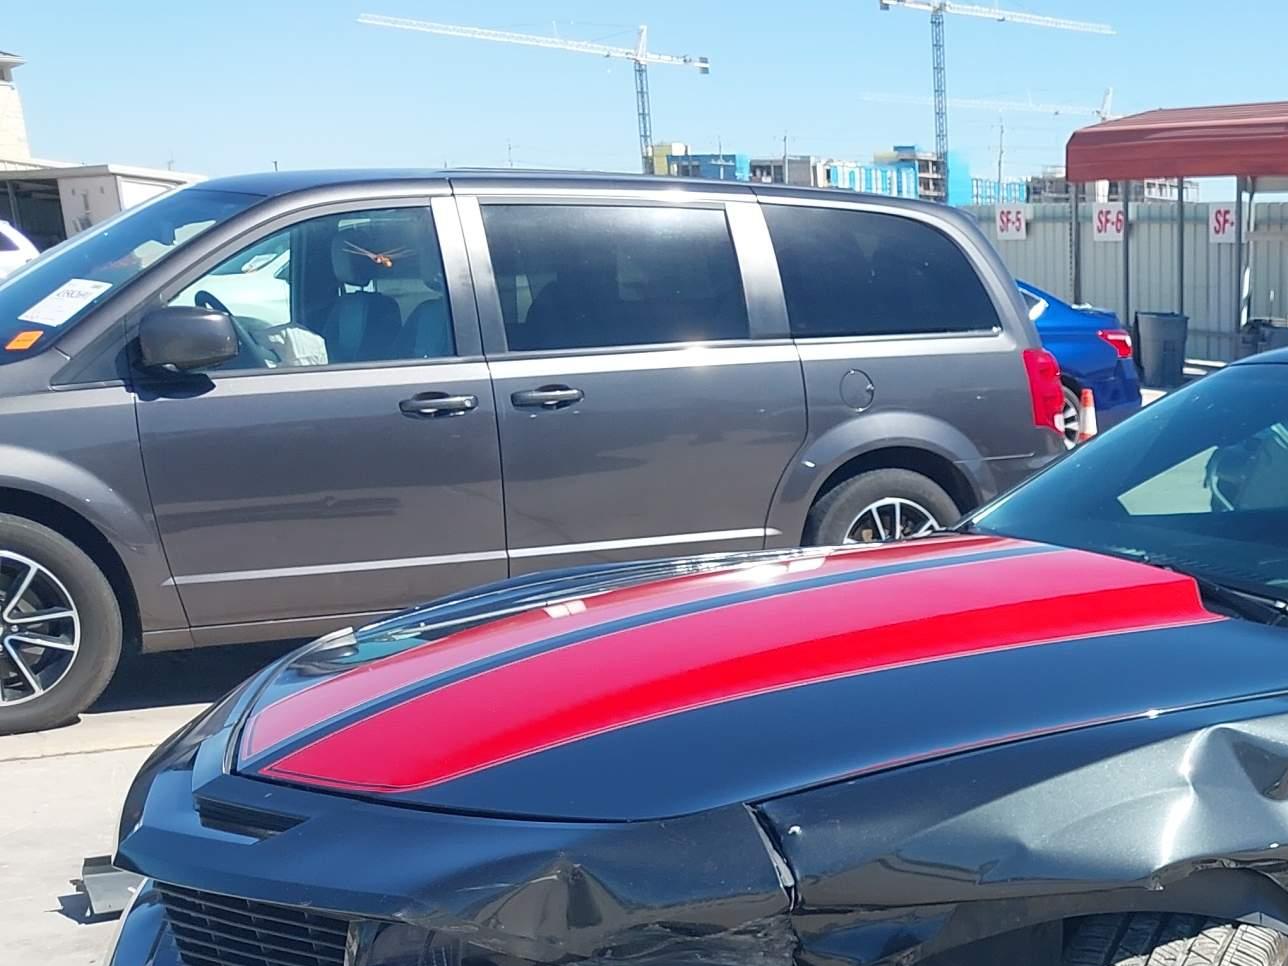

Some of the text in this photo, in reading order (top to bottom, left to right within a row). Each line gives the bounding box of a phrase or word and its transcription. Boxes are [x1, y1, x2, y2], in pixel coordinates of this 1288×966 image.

[999, 210, 1022, 232] SF-5
[1097, 210, 1125, 233] SF-6
[1213, 209, 1236, 235] SF-
